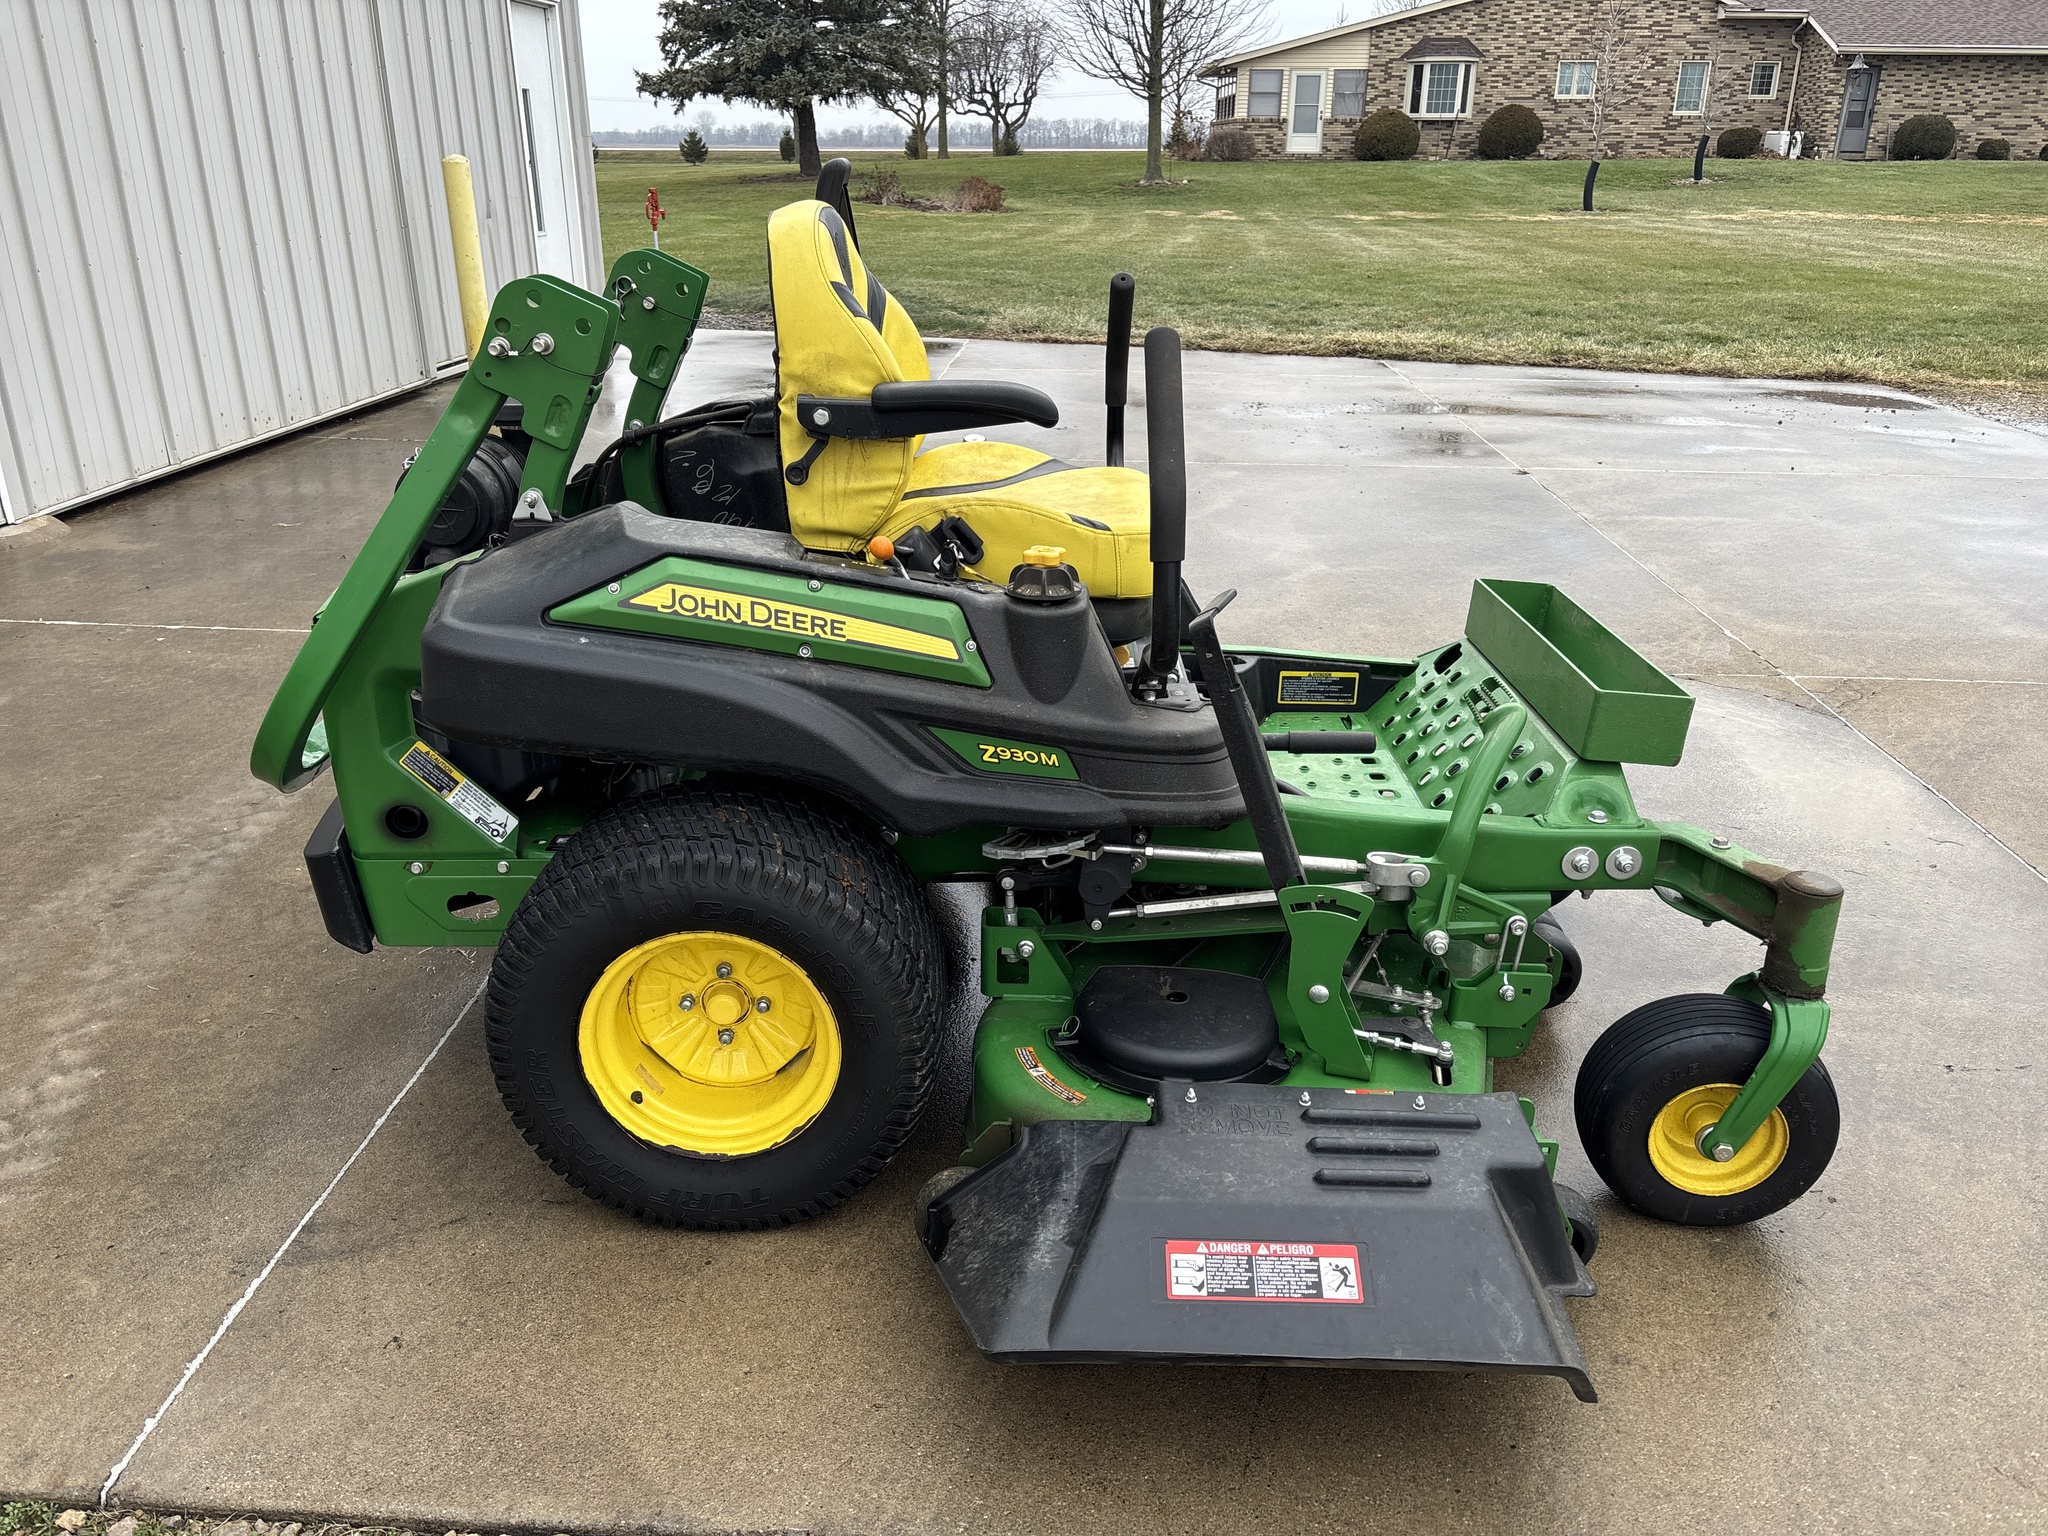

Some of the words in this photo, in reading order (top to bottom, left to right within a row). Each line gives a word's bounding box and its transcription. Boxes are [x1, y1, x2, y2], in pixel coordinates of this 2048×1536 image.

[661, 587, 742, 621] JOHN
[750, 600, 847, 639] DEERE
[429, 753, 454, 775] CAUTION
[978, 743, 1060, 767] Z930M
[690, 900, 882, 1039] CARLISLE
[525, 1047, 648, 1194] MASTER
[1230, 1103, 1287, 1121] NOT
[648, 1187, 772, 1213] TURF
[1209, 1243, 1252, 1254] DANGER
[1269, 1244, 1314, 1255] PELIGRO
